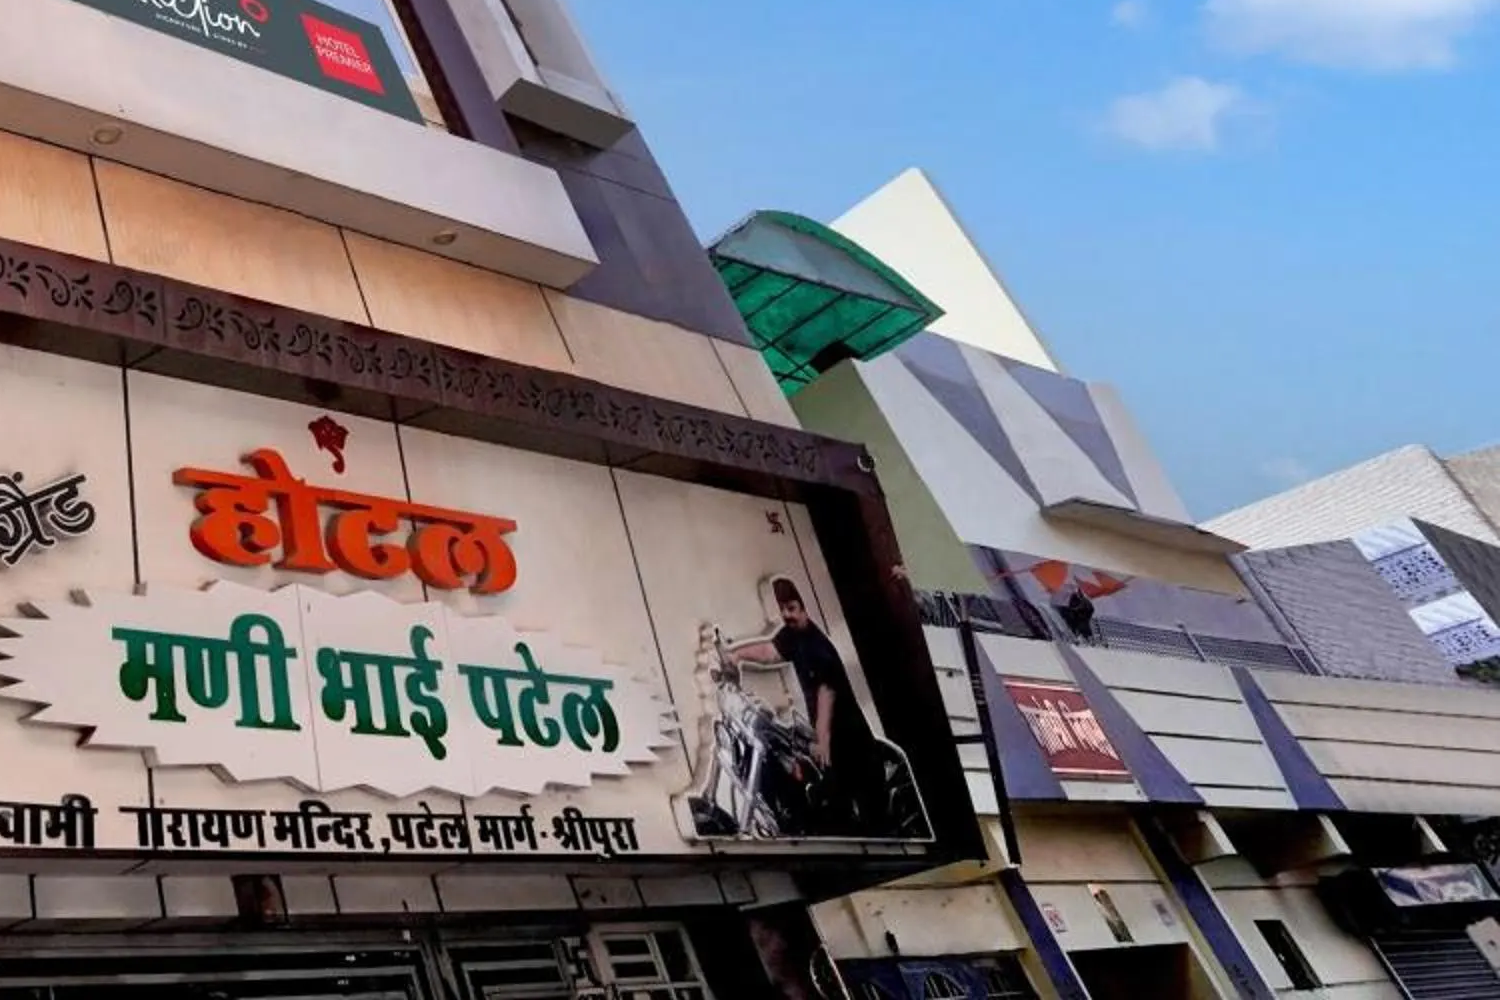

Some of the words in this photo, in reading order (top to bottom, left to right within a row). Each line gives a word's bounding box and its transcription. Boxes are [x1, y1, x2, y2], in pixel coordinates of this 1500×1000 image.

[172, 448, 518, 595] होटल
[112, 613, 301, 731] मणी
[315, 625, 449, 760] भाई
[457, 641, 621, 753] पटेल
